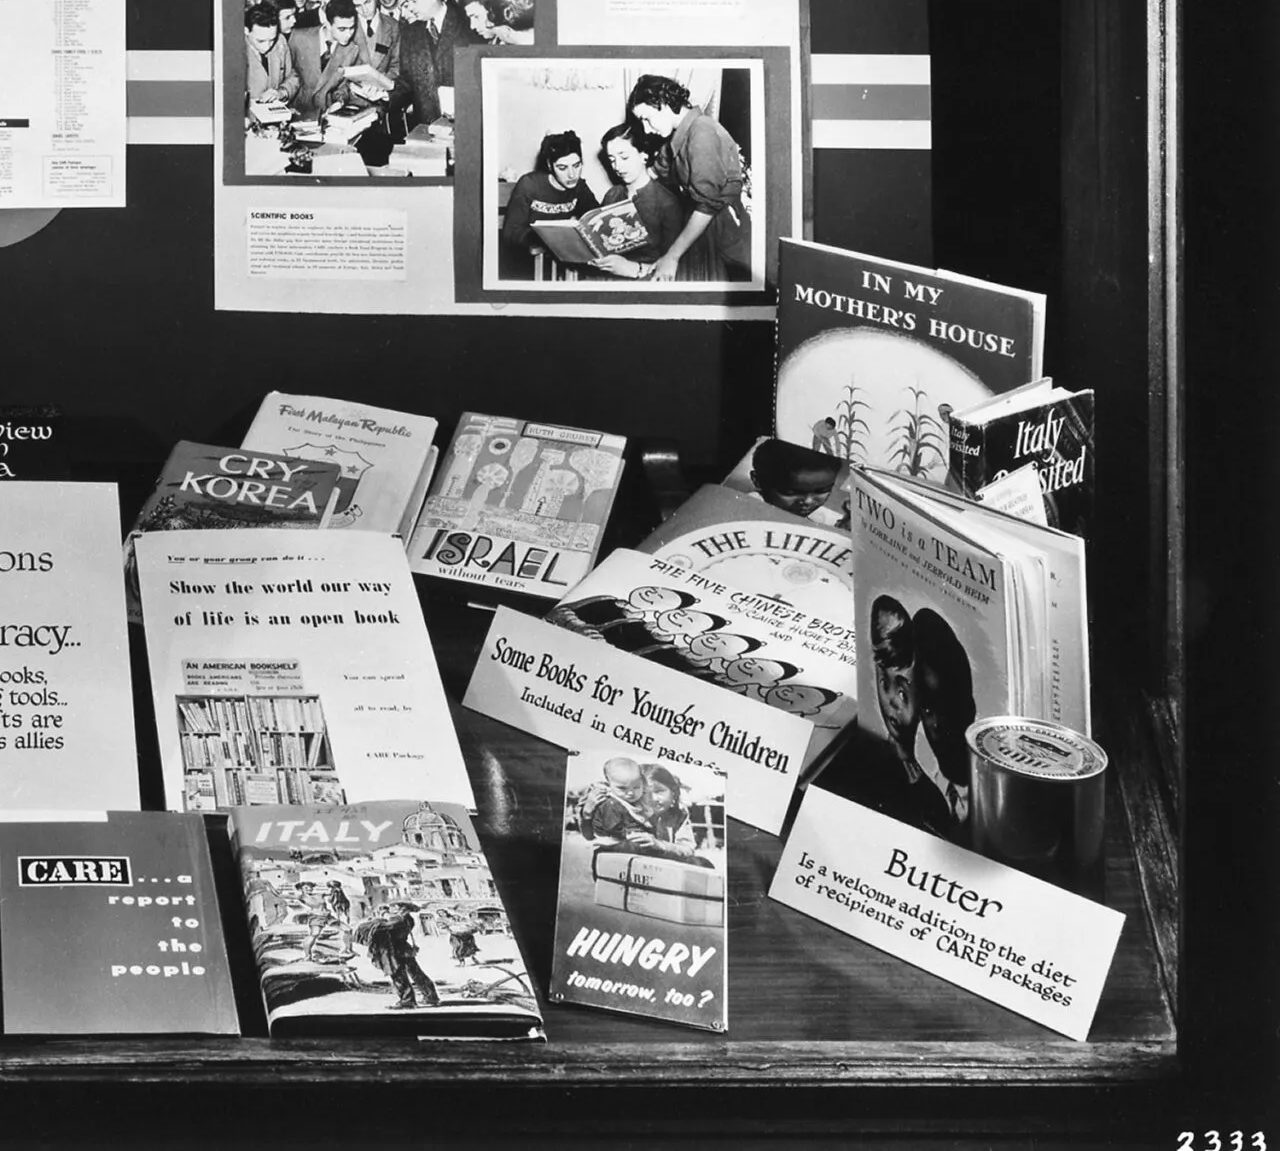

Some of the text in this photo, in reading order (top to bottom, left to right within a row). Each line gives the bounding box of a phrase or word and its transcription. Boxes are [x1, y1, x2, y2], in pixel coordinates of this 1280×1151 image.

[250, 212, 287, 220] SCIENTIFIC
[862, 271, 943, 305] IN MY
[795, 284, 1015, 358] MOTHER'S HOUSE
[219, 454, 308, 482] CRY
[179, 471, 318, 514] KOREA
[423, 528, 568, 587] ISRAEL
[170, 579, 391, 596] Show the world our way
[491, 637, 789, 774] Some Books for Younger Children
[255, 820, 393, 843] ITALY
[27, 861, 122, 882] CARE
[884, 849, 1003, 918] Butter
[567, 927, 716, 978] HUNGRY
